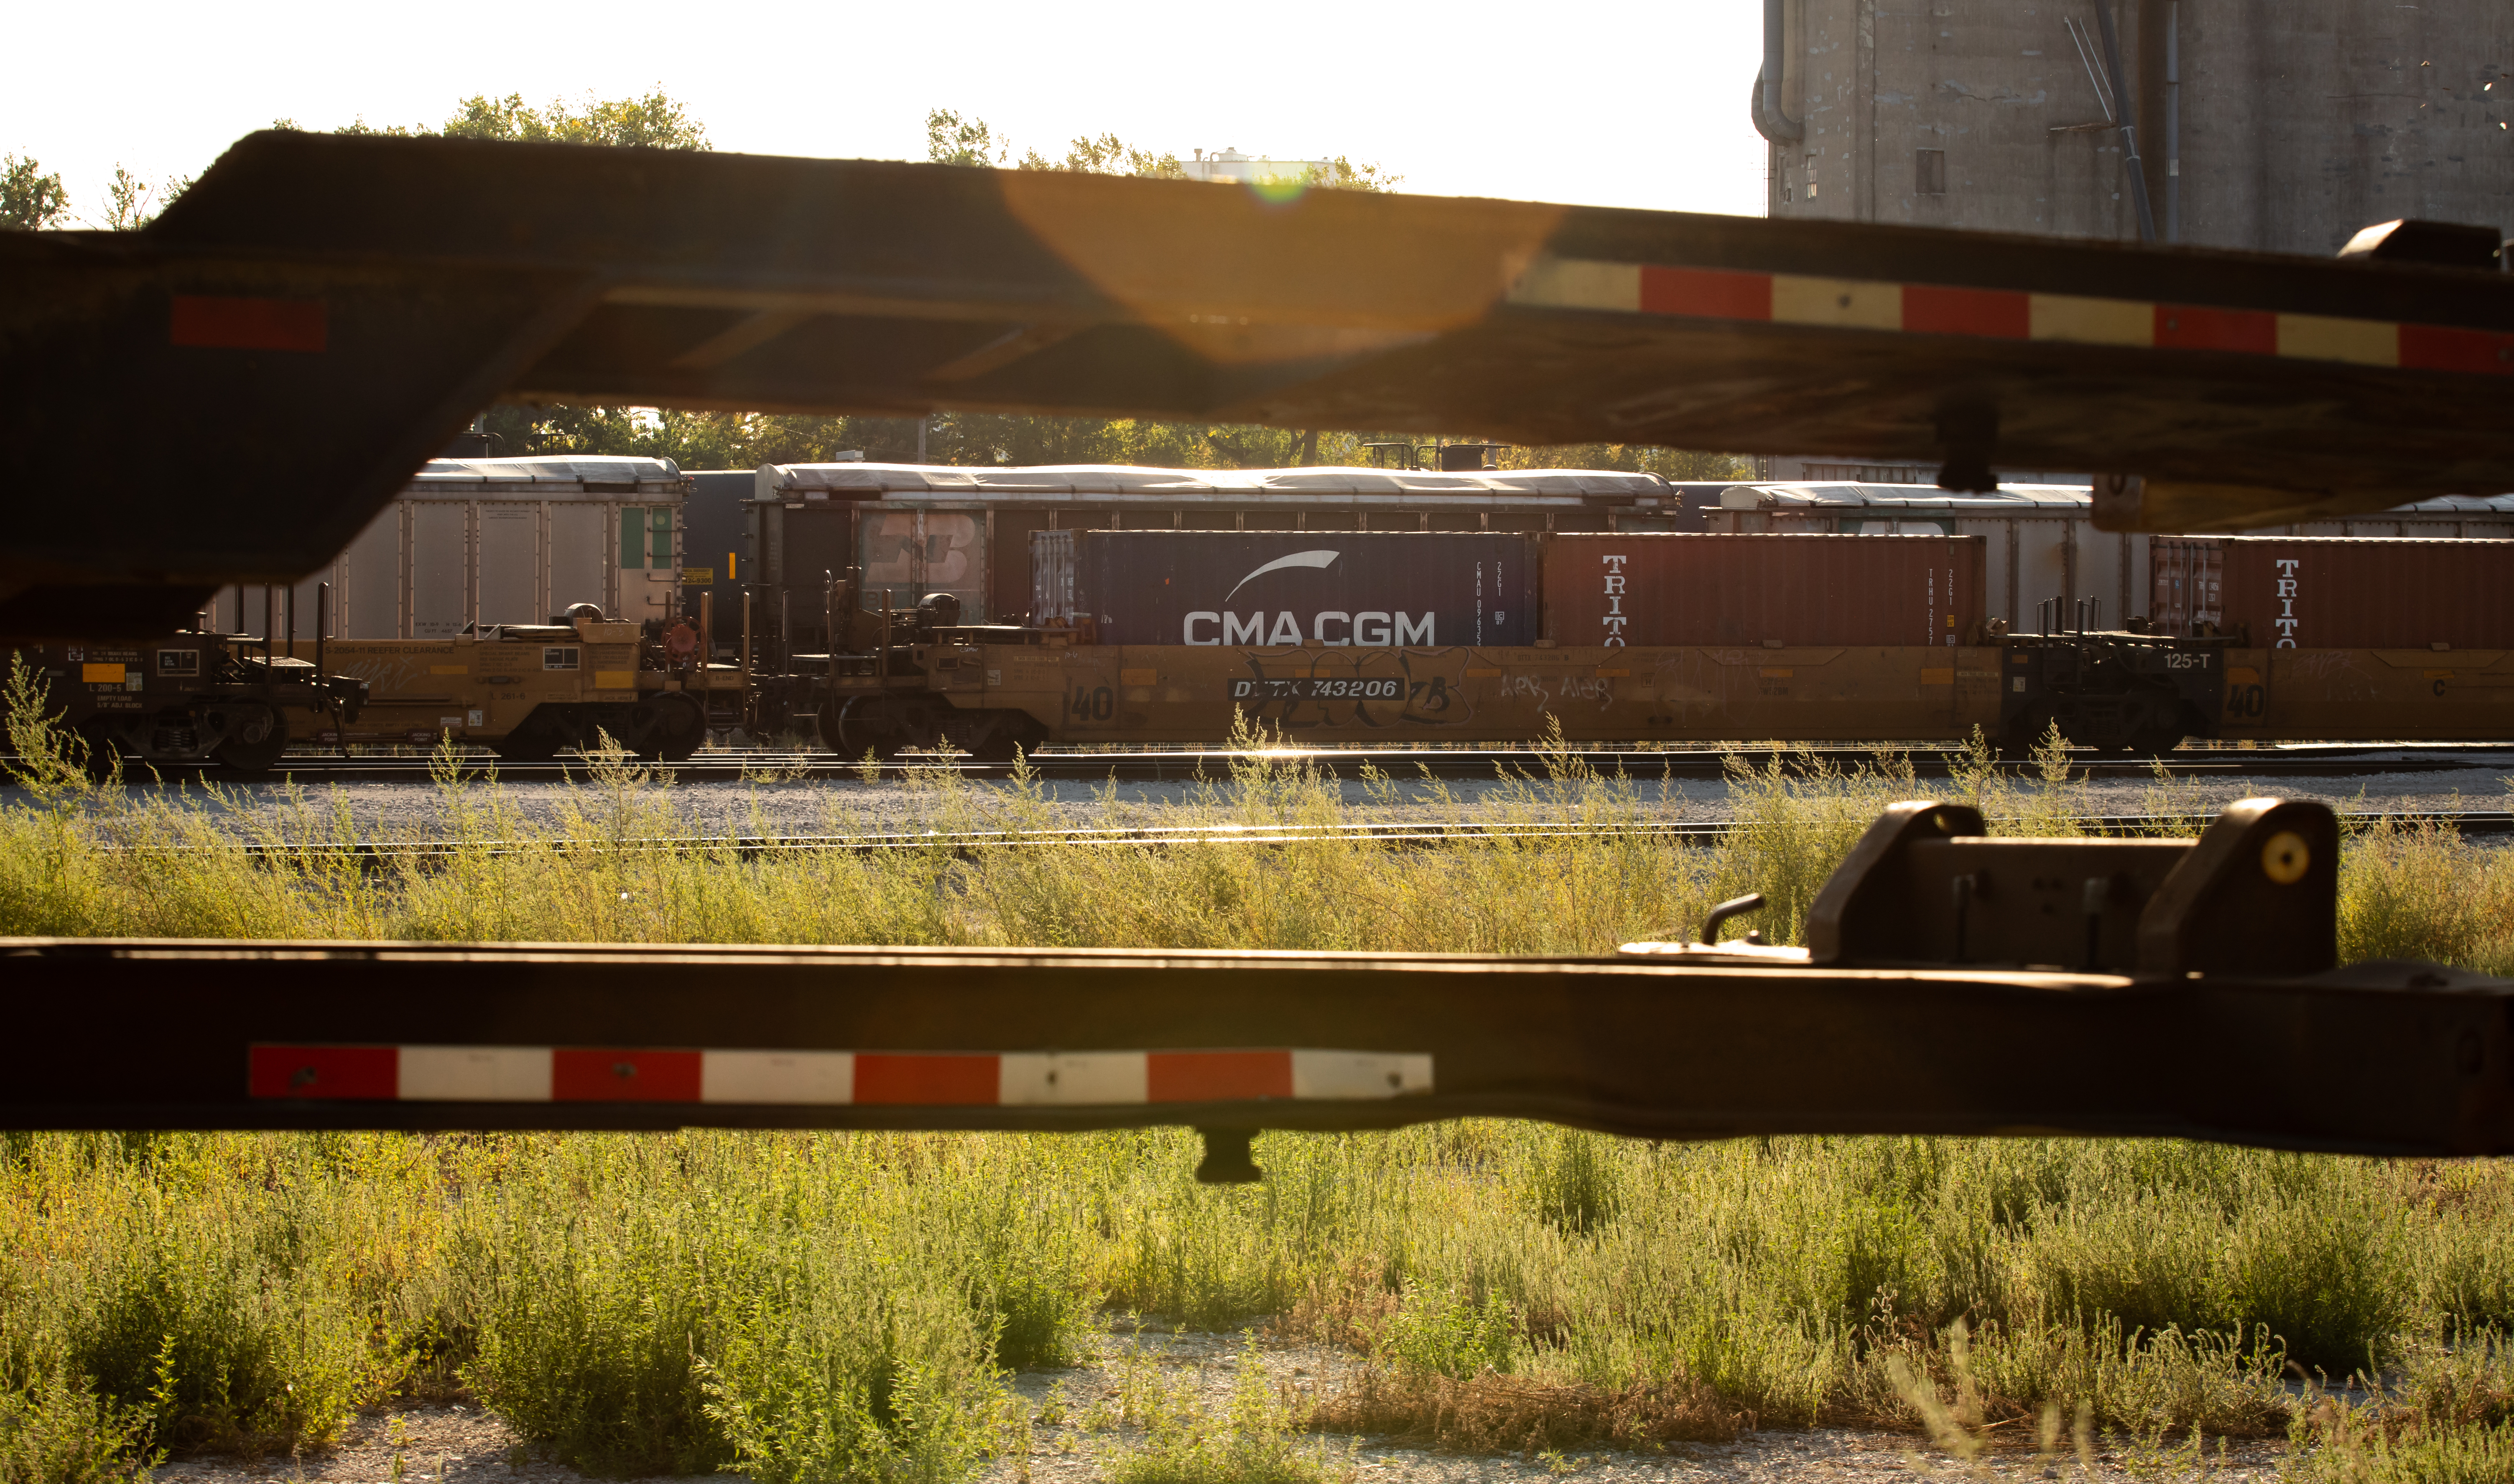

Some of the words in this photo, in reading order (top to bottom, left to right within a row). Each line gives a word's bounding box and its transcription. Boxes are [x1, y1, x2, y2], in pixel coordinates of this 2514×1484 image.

[1183, 611, 1303, 646] CMA
[1314, 611, 1434, 646] CGM
[2164, 653, 2211, 668] 125-T
[1234, 681, 1301, 697] DTX
[2227, 684, 2264, 717] 40
[2433, 679, 2445, 697] C
[1071, 686, 1113, 721] 40
